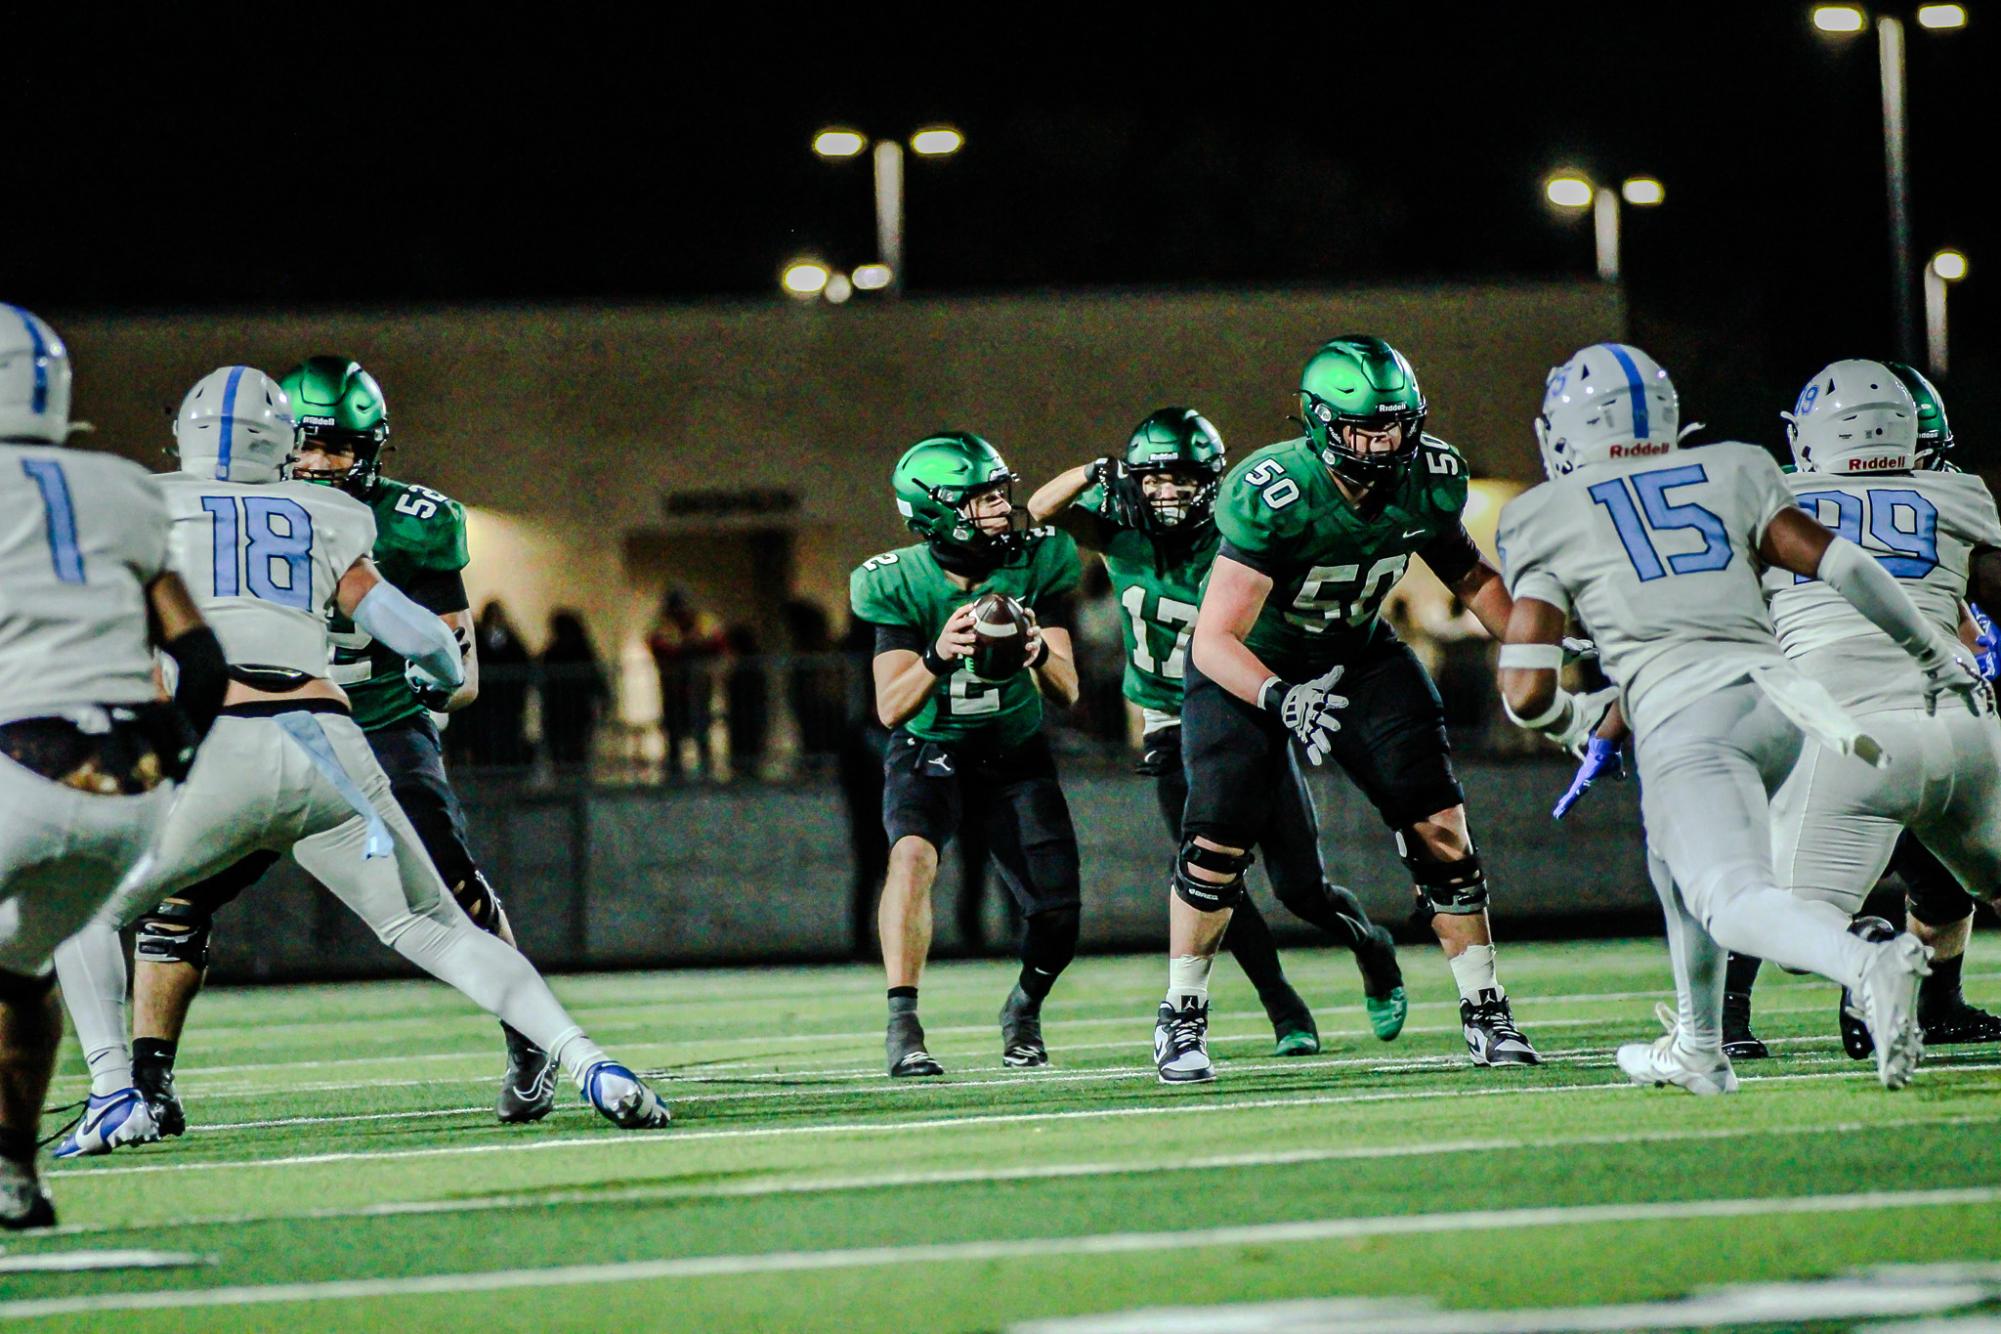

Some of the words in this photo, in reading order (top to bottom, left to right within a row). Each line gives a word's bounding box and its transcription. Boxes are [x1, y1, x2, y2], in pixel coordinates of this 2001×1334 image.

[1378, 403, 1407, 413] Riddell
[1244, 457, 1301, 511] 50
[1609, 442, 1670, 459] Riddell
[1848, 455, 1906, 471] Riddell
[20, 459, 88, 585] 1
[200, 495, 315, 614] 18
[1587, 463, 1735, 583] 15
[862, 552, 900, 573] 2
[1283, 553, 1409, 634] 50
[1121, 585, 1200, 679] 17
